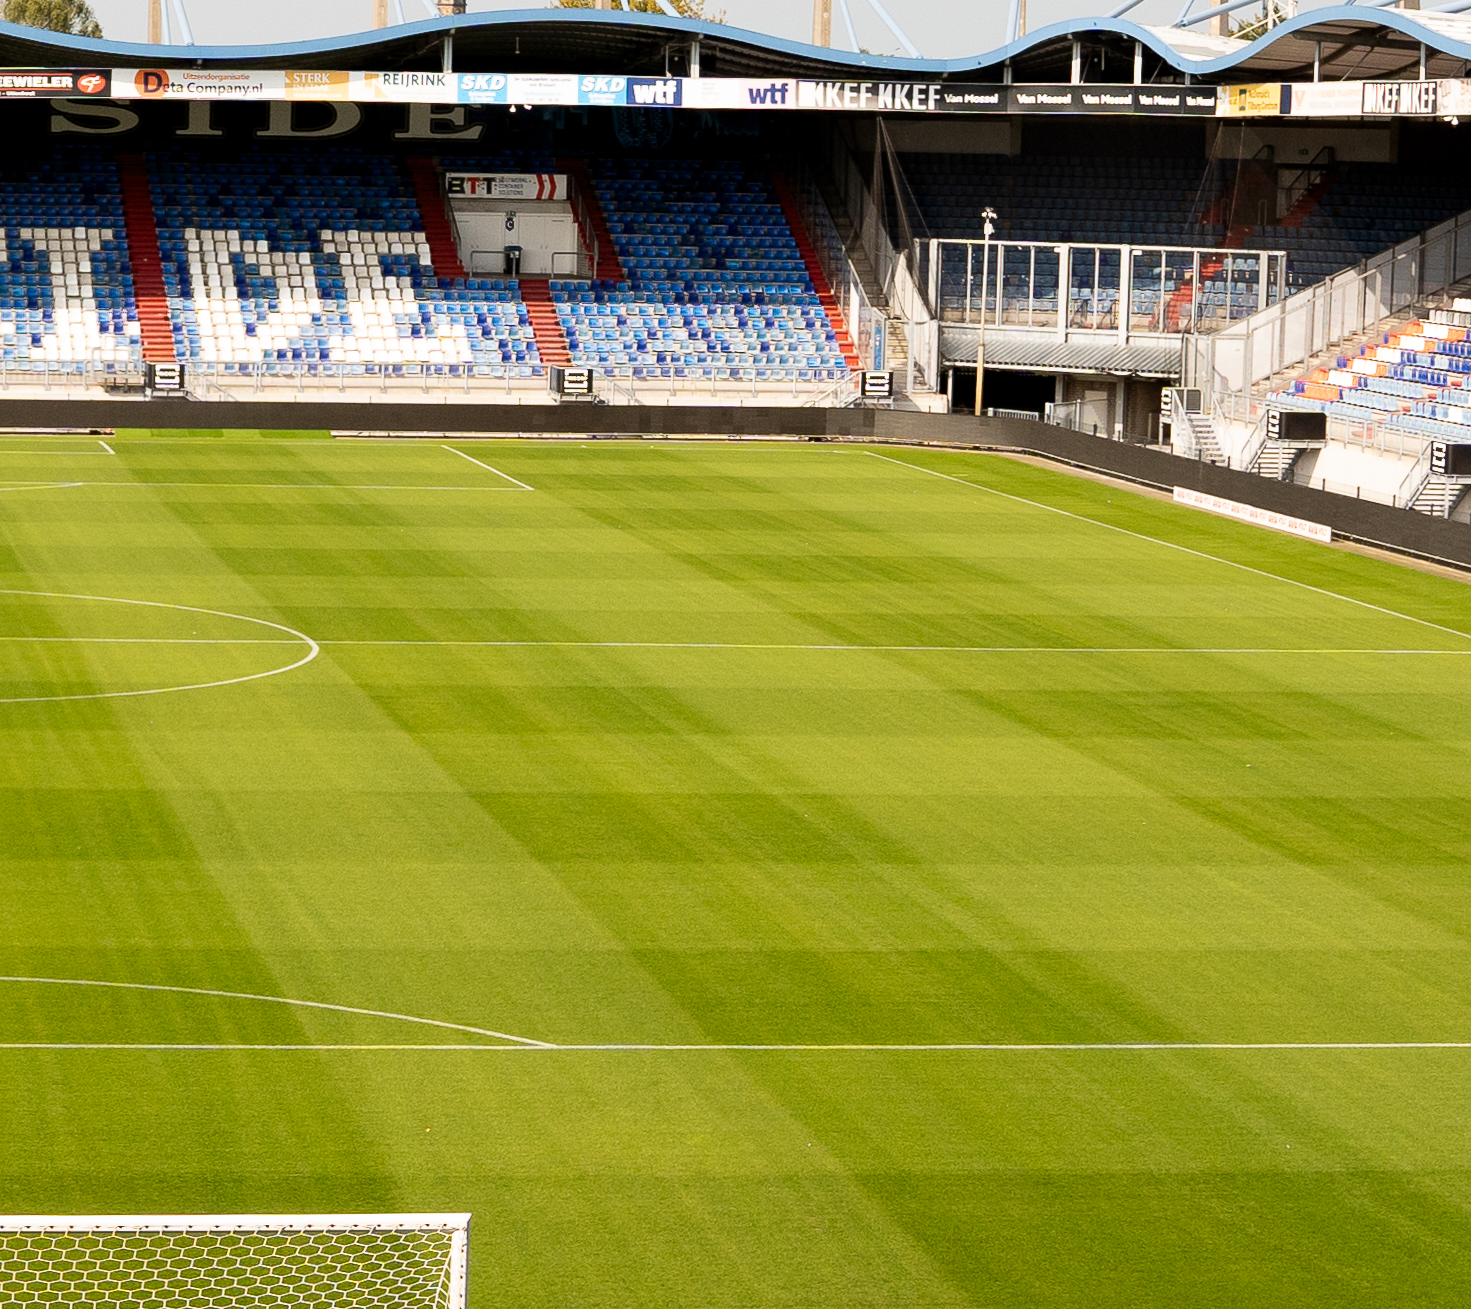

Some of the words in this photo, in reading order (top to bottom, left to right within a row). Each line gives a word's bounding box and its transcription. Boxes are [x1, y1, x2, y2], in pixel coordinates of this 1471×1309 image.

[143, 71, 184, 93] Deta
[187, 81, 263, 96] Company.nl
[293, 73, 331, 84] STERK
[383, 72, 446, 88] REIJRINK
[461, 74, 506, 91] SKD
[581, 76, 625, 93] SKD
[633, 81, 677, 106] wtf
[748, 82, 787, 106] wtf
[944, 94, 963, 104] Van
[964, 93, 999, 104] Mossel
[1016, 94, 1036, 104] Van
[1037, 94, 1072, 104] Mossel
[1082, 94, 1100, 105] Van
[1101, 94, 1133, 105] Mossel
